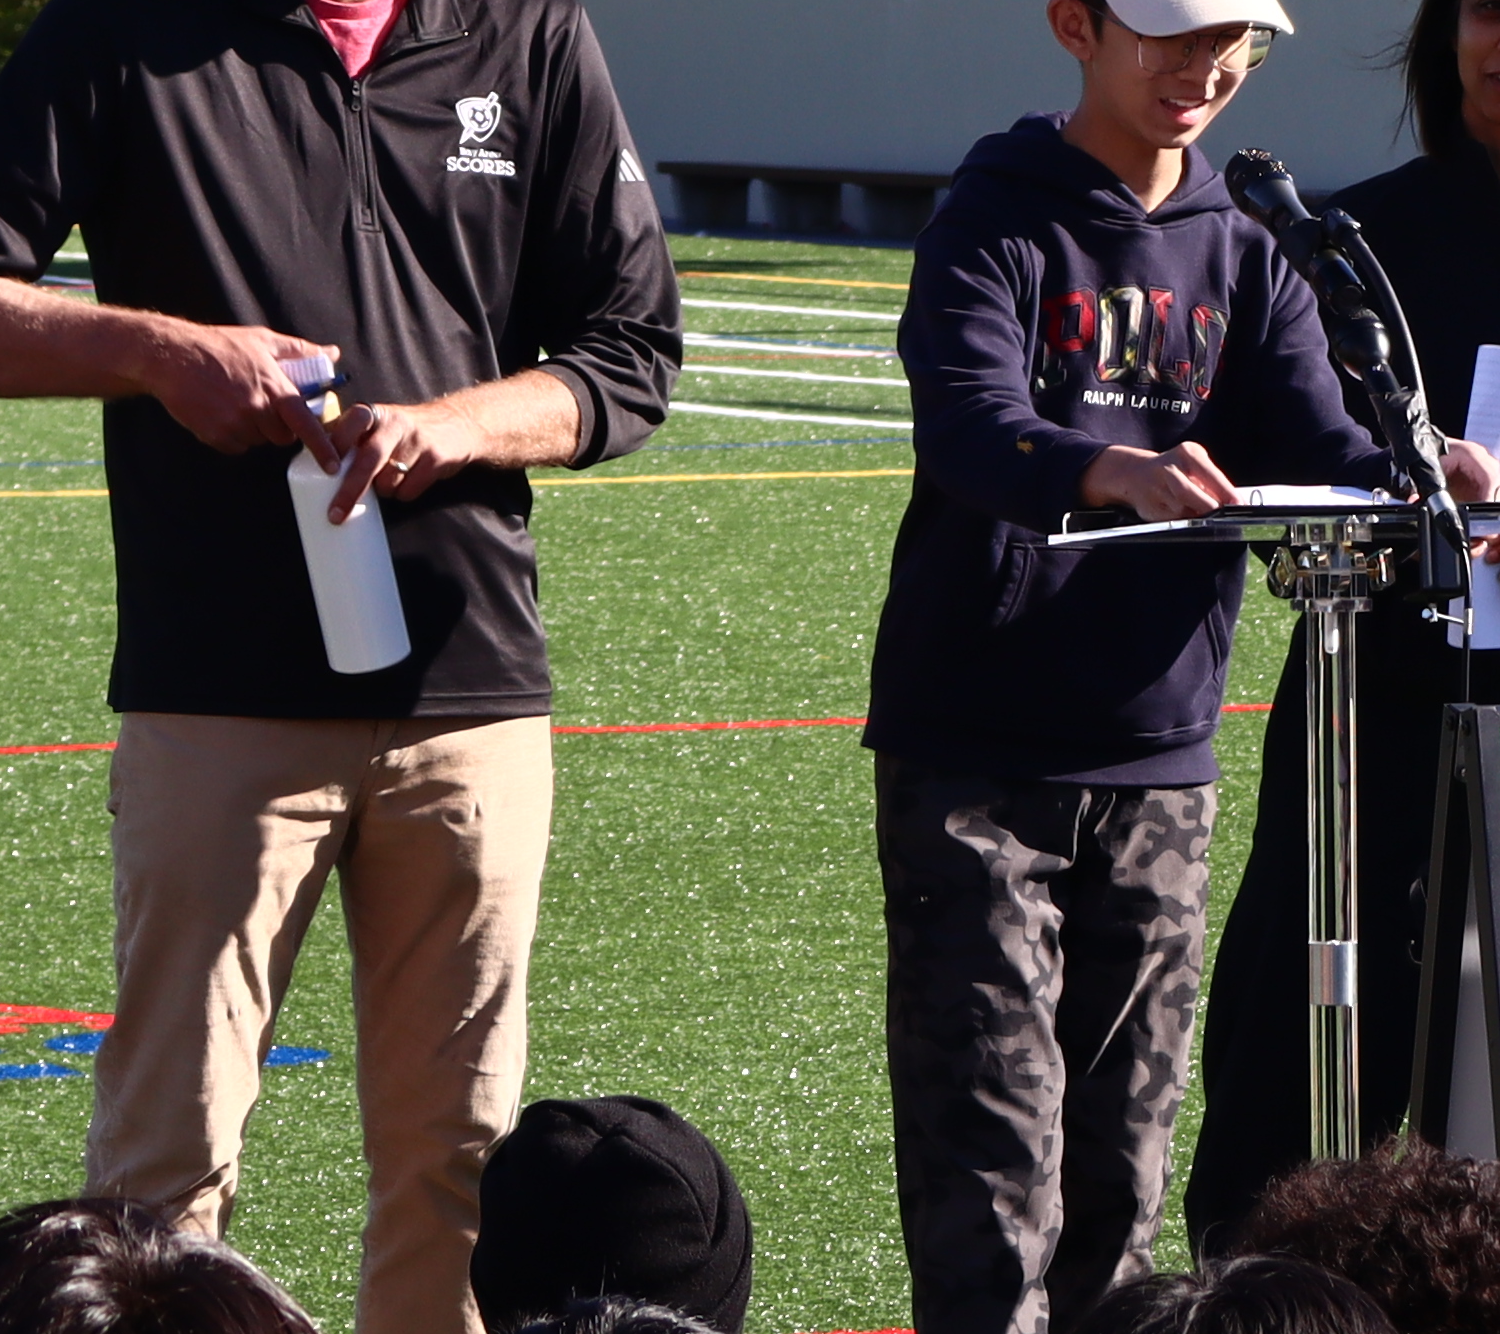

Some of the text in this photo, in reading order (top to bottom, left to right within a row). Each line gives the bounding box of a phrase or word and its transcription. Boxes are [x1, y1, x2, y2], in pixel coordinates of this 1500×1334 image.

[446, 155, 516, 177] SCORES
[1083, 389, 1191, 415] RALPH LAUREN
